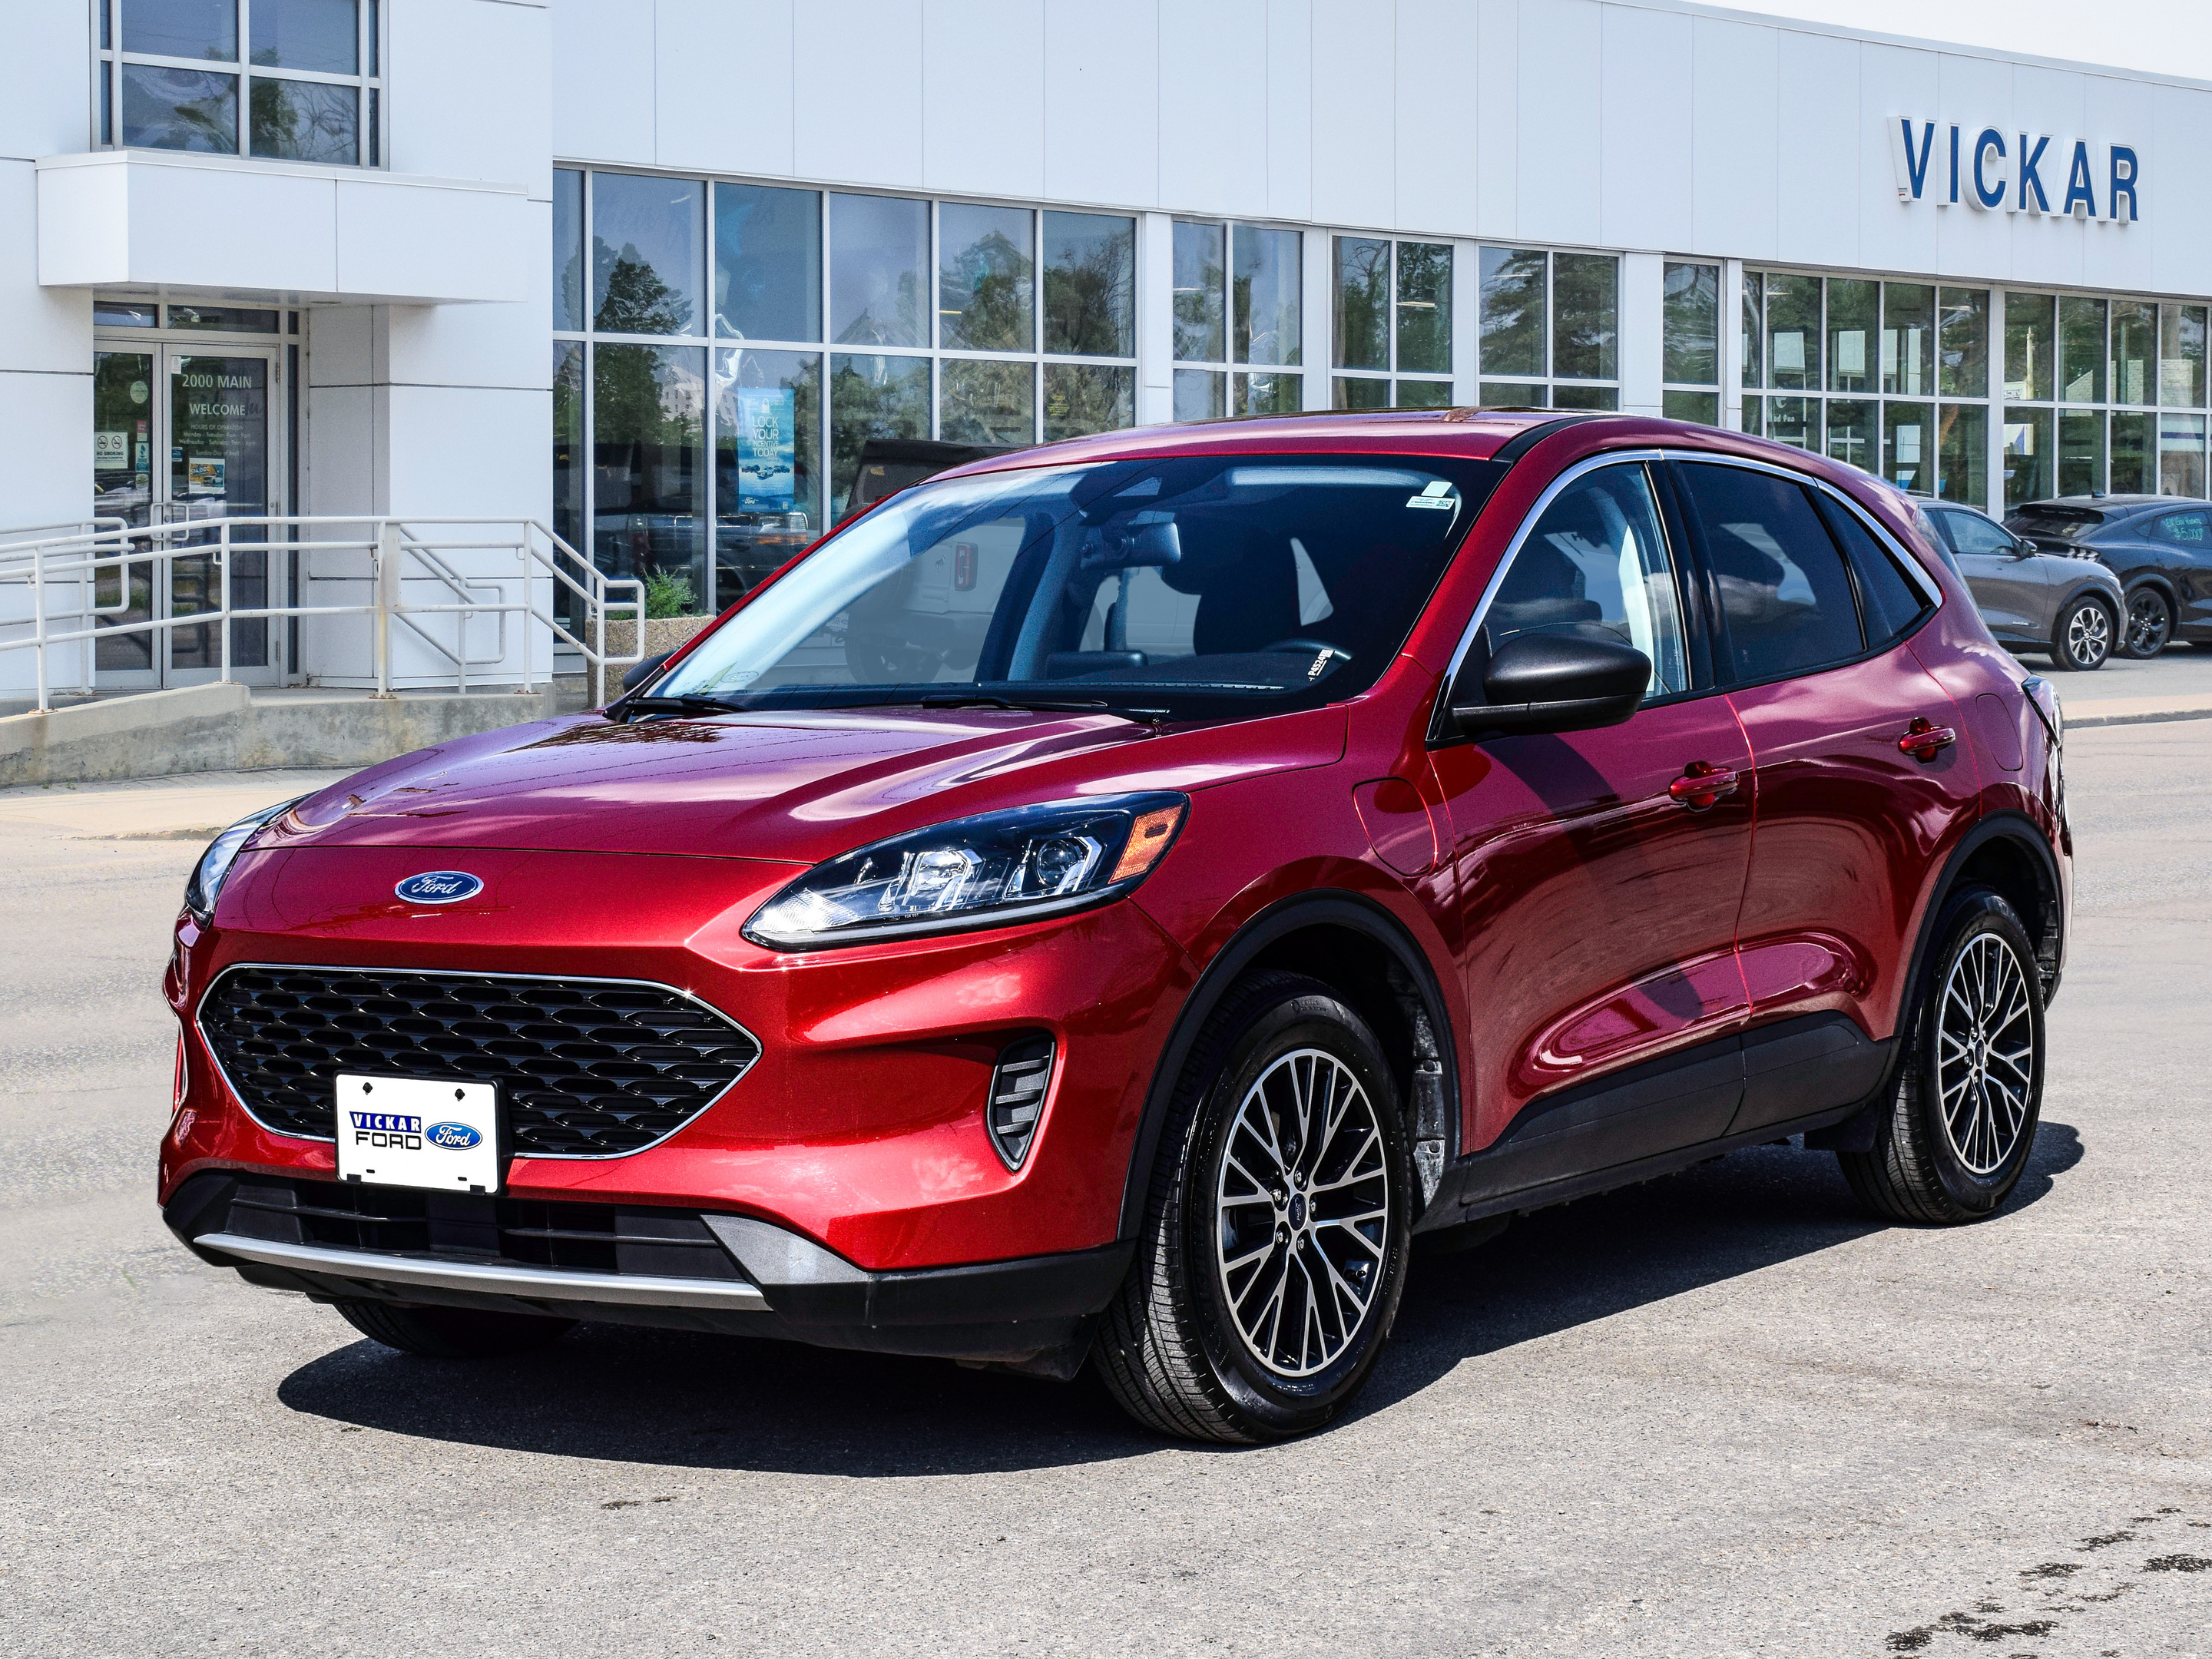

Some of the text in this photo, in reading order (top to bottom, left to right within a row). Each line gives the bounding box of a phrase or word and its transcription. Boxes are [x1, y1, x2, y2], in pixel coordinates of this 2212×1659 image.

[1897, 115, 2139, 223] VICKAR
[182, 374, 252, 389] 2000 MAIN
[189, 403, 246, 416] WELCOME
[752, 416, 779, 428] LOCK
[752, 429, 780, 440] YOUR
[753, 448, 779, 457] TODAY
[411, 876, 462, 894] Ford
[353, 1113, 472, 1147] VICKAR Ford
[356, 1131, 422, 1151] FORD
